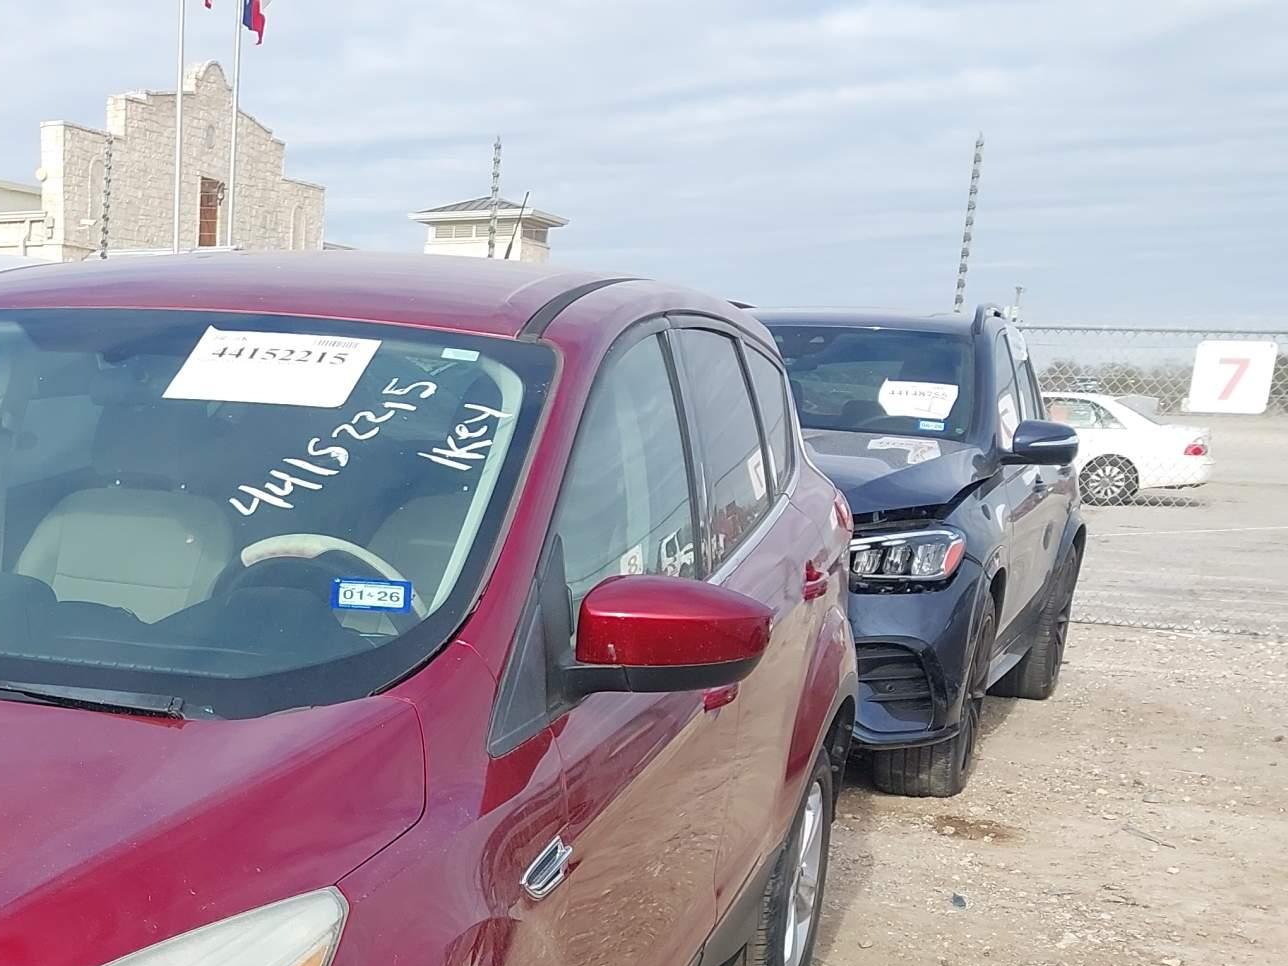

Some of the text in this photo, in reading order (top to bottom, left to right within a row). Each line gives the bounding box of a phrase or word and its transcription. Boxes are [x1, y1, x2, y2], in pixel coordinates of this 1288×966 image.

[211, 346, 350, 366] 44152215
[1217, 357, 1251, 401] 7
[228, 377, 437, 516] 44152215
